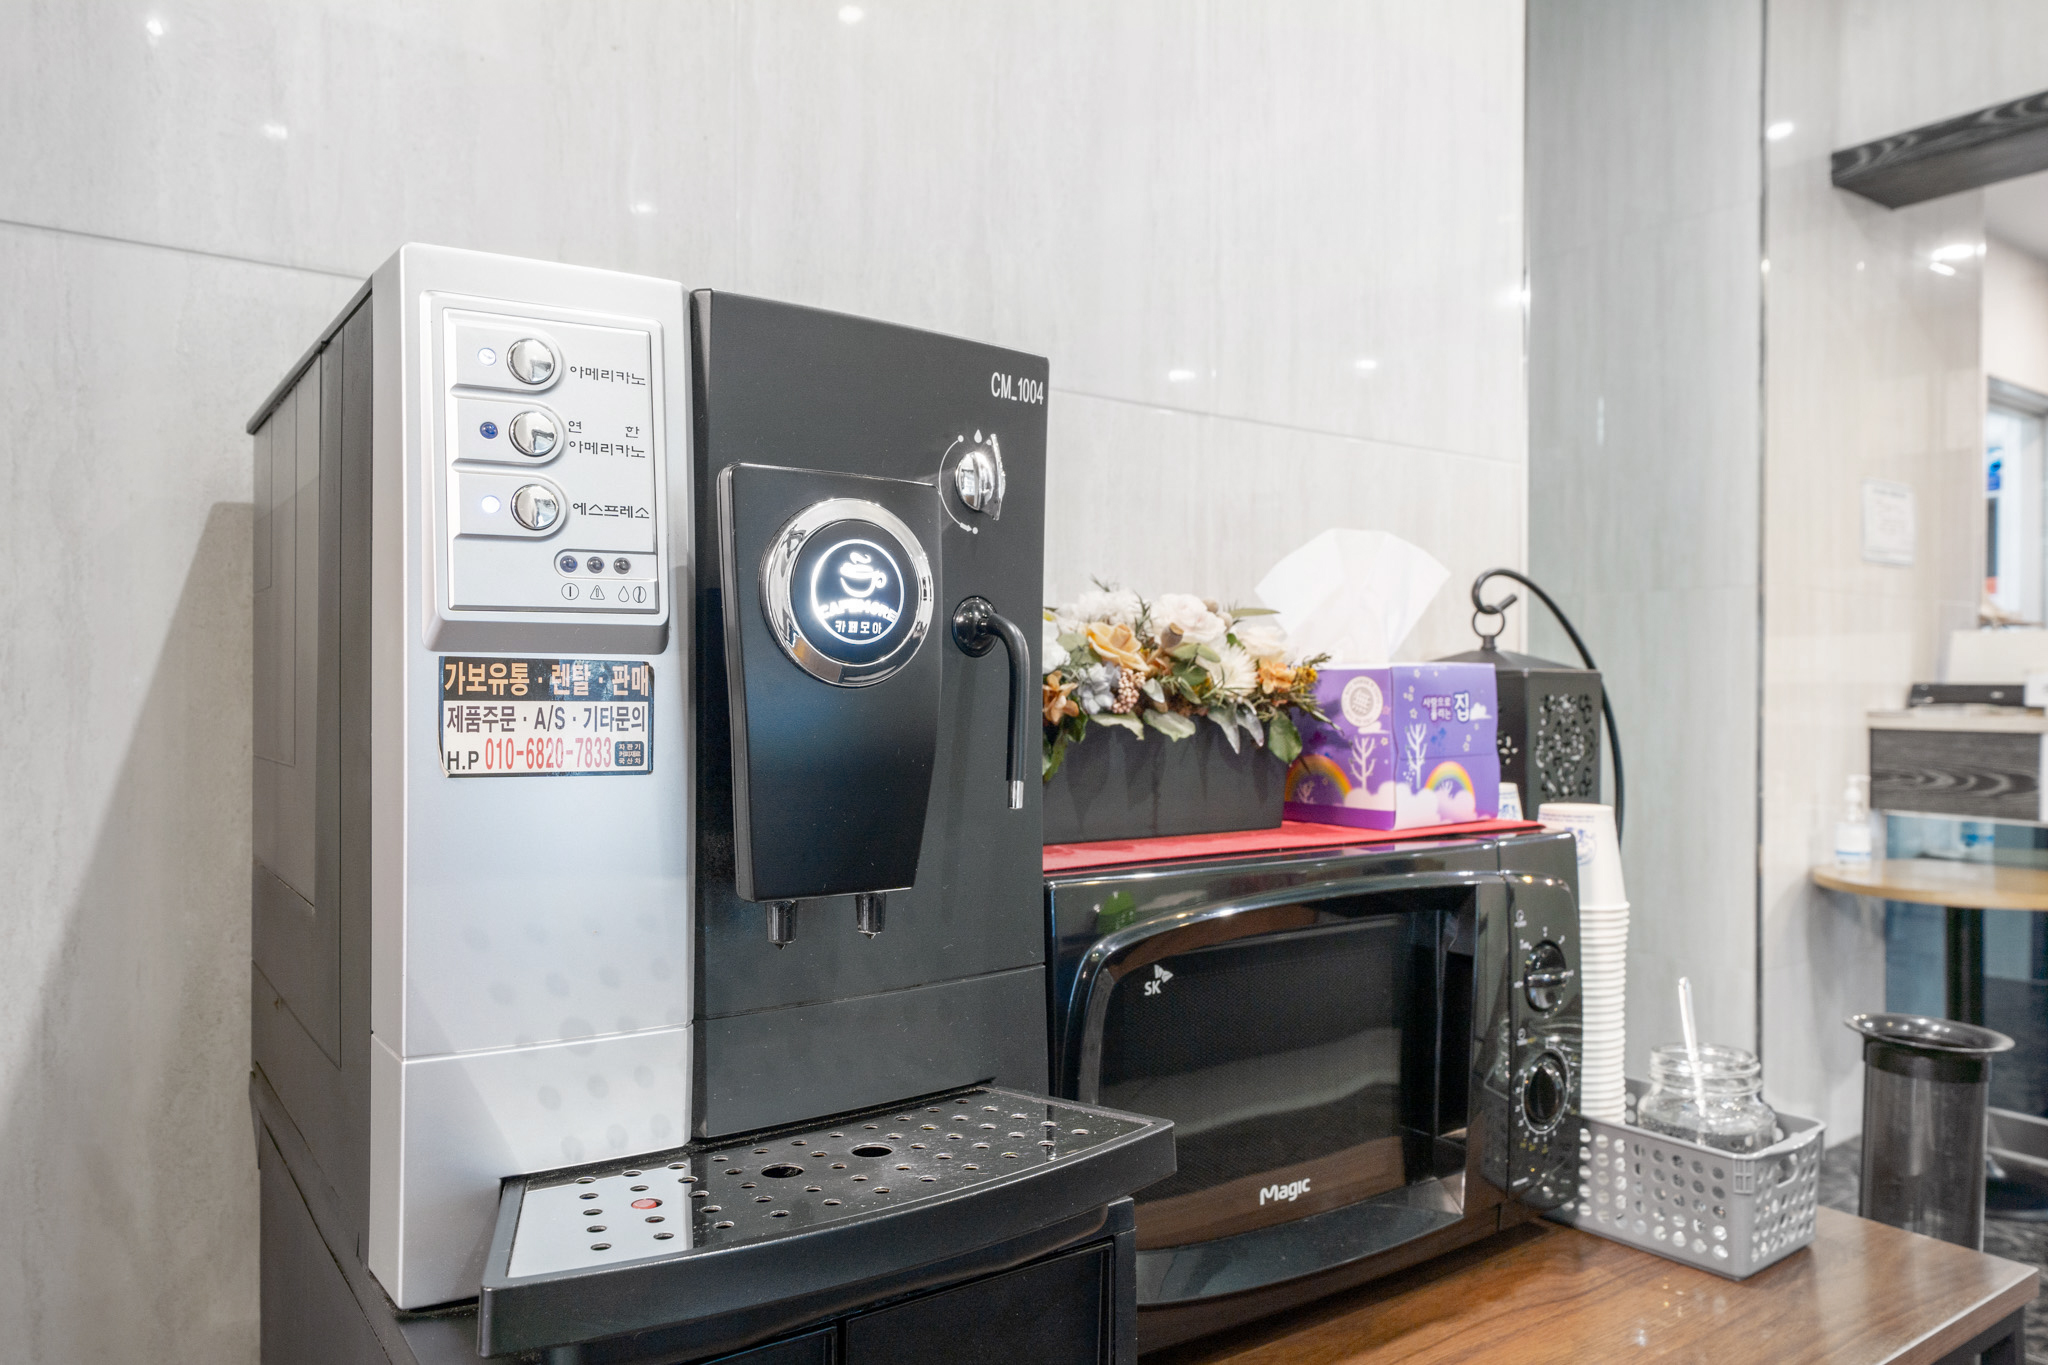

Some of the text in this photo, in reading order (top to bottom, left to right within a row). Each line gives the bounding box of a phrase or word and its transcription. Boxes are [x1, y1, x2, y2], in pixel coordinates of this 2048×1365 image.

[569, 366, 646, 386] 아메리카노
[569, 440, 646, 459] 아메리카노
[572, 502, 650, 519] 에스프레소
[834, 620, 883, 634] 카페모아
[444, 661, 649, 697] 가보유통 렌탈 판매
[446, 705, 645, 733] 제품주문 A/S 기타문의
[1454, 692, 1470, 722] 집
[447, 736, 612, 770] H.P 010-6820-7833
[1143, 979, 1162, 996] SK
[1259, 1178, 1312, 1206] Magic
